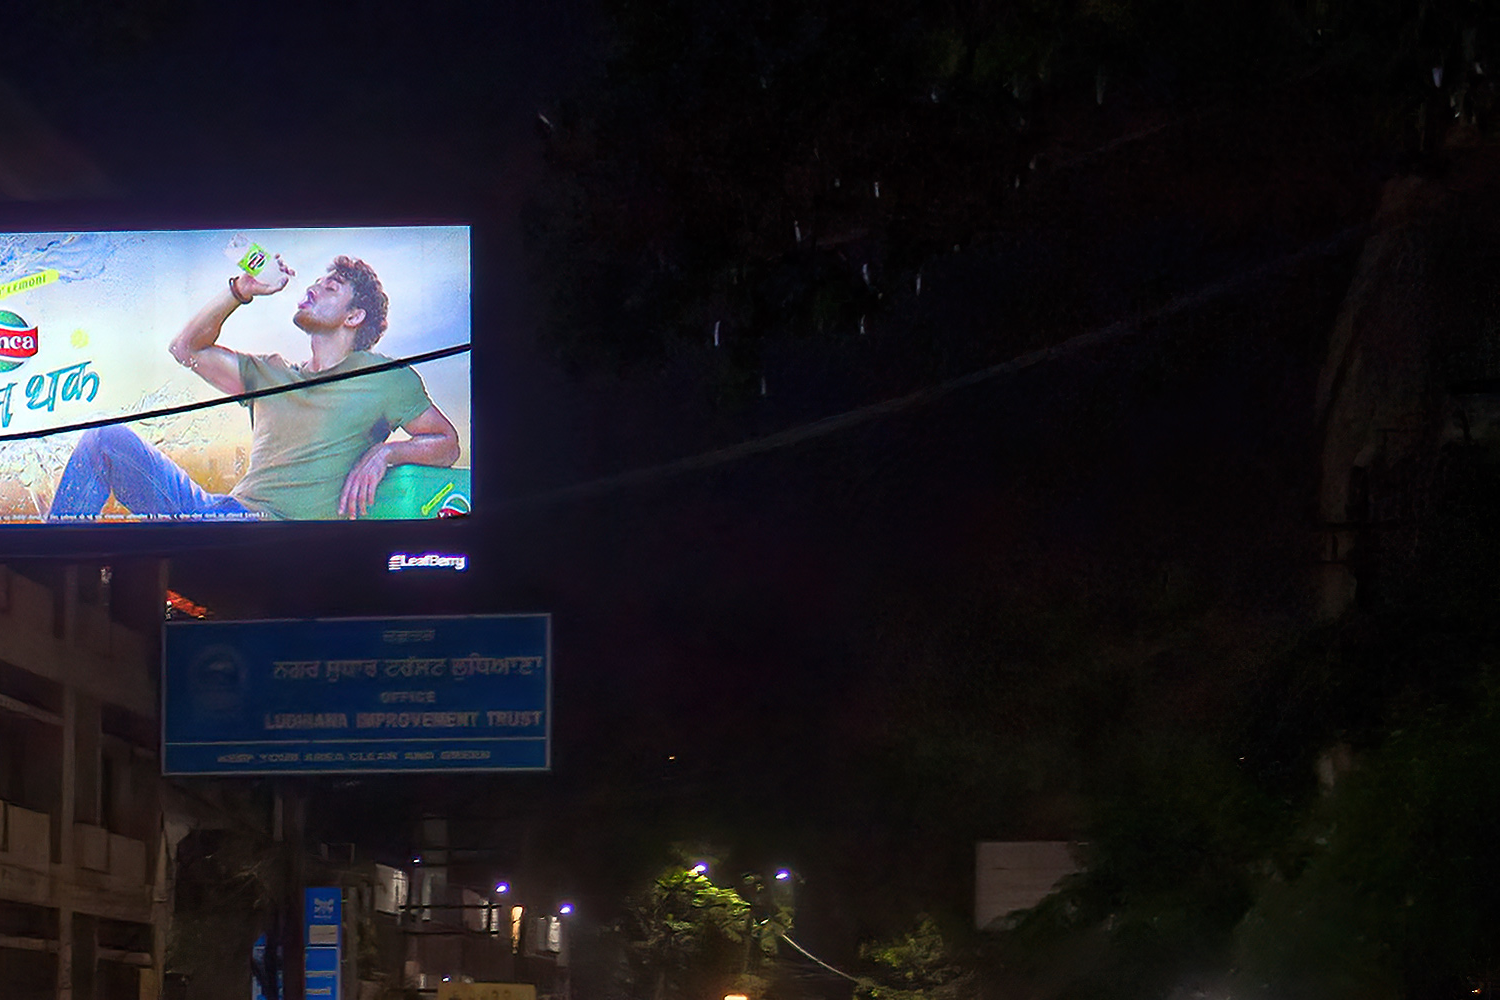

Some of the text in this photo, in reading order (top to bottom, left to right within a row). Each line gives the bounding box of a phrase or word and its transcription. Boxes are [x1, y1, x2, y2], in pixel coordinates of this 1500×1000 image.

[25, 360, 100, 412] थक
[264, 710, 544, 731] LUDHIANA IMPROVEMENT TRUST
